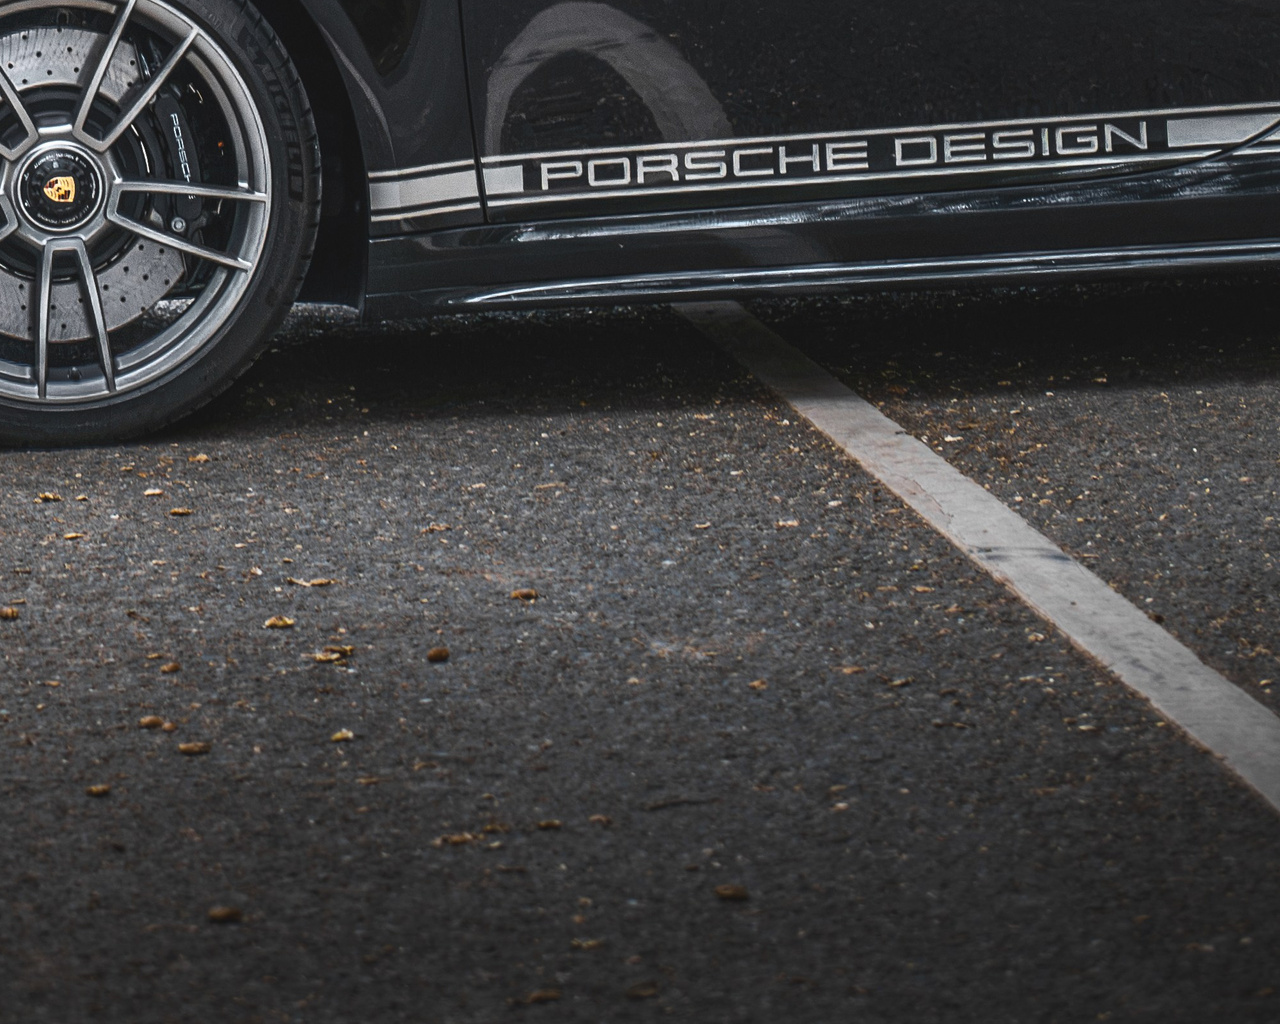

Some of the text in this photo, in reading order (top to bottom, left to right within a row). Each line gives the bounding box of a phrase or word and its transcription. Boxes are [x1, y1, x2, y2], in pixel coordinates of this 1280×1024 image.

[170, 113, 195, 199] PORSC
[541, 121, 1148, 191] PORSCHE DESIGN
